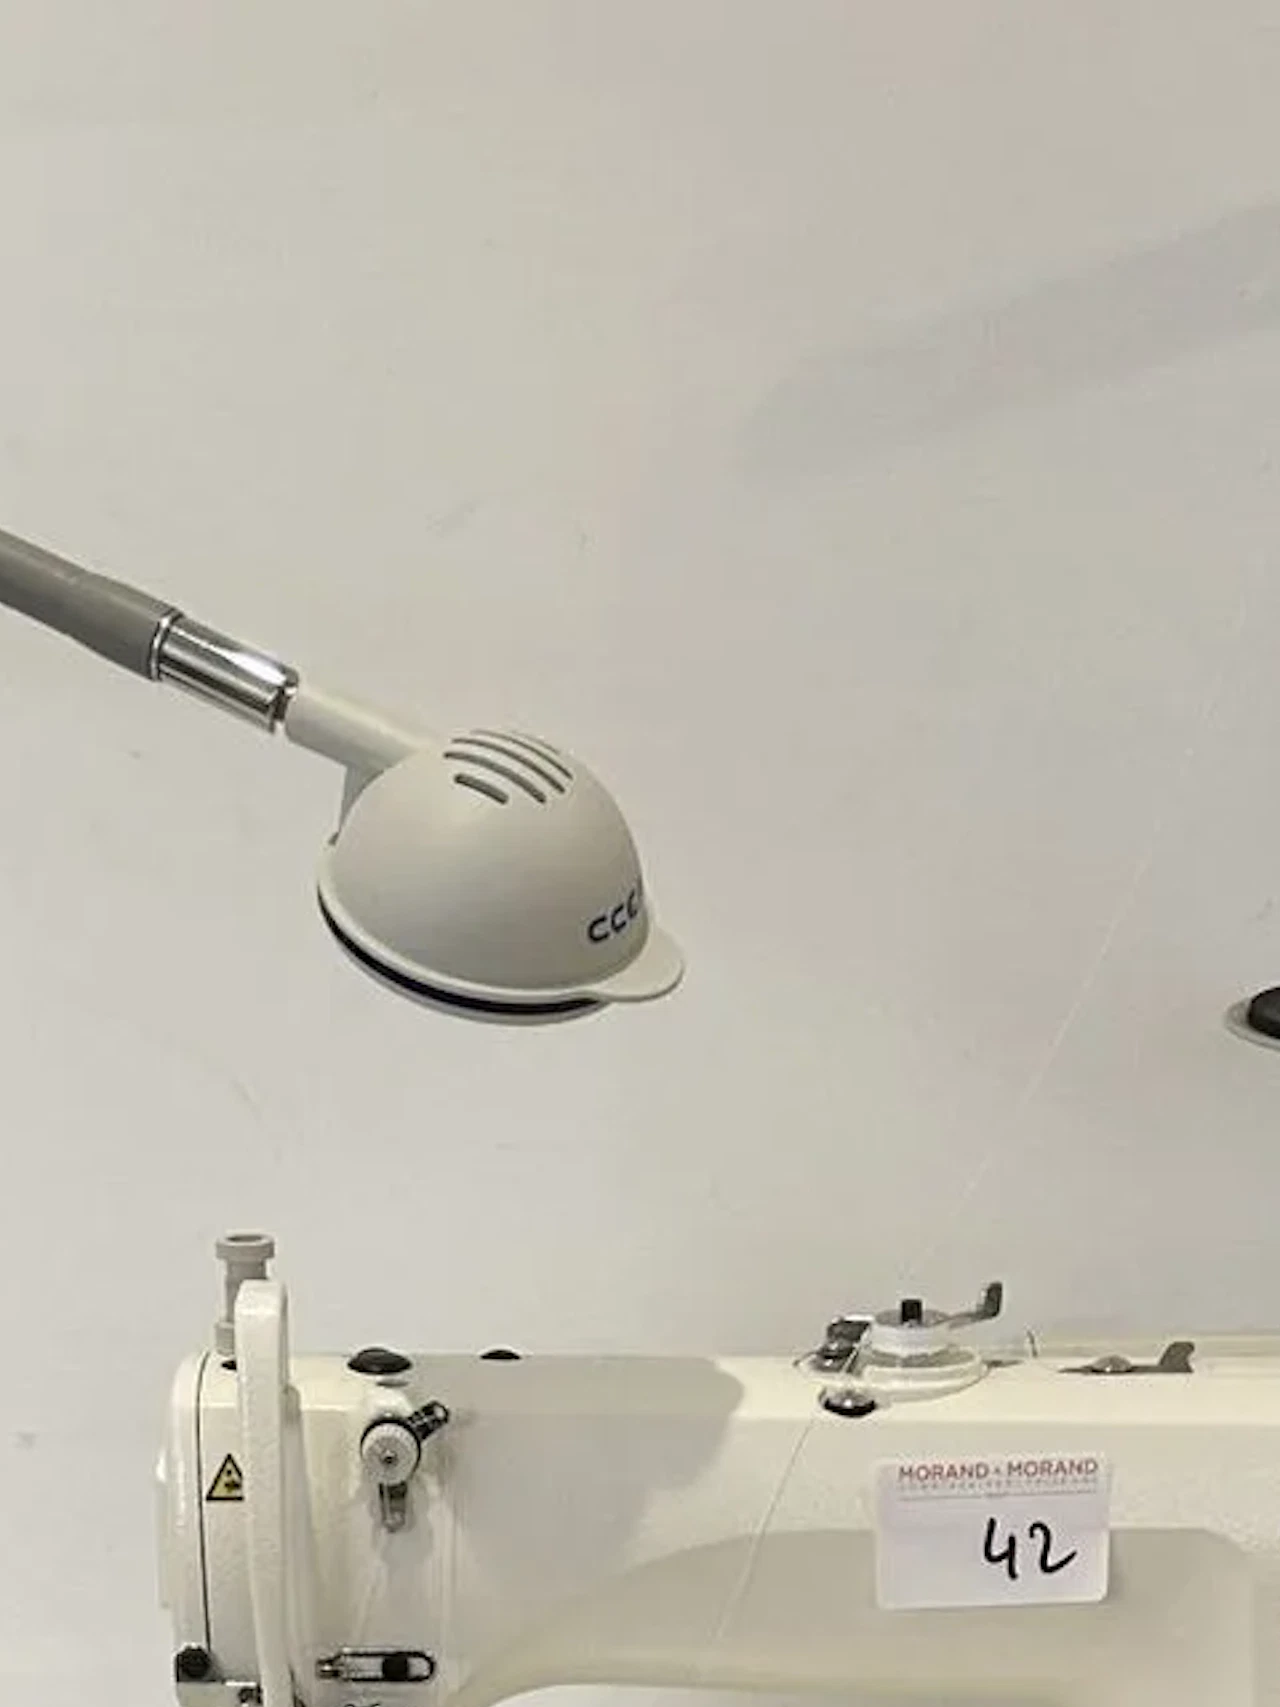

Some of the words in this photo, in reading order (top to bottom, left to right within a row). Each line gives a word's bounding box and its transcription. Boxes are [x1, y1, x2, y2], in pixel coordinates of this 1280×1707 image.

[898, 1463, 989, 1483] MORAND
[1007, 1458, 1099, 1478] MORAND
[982, 1516, 1078, 1581] 42
